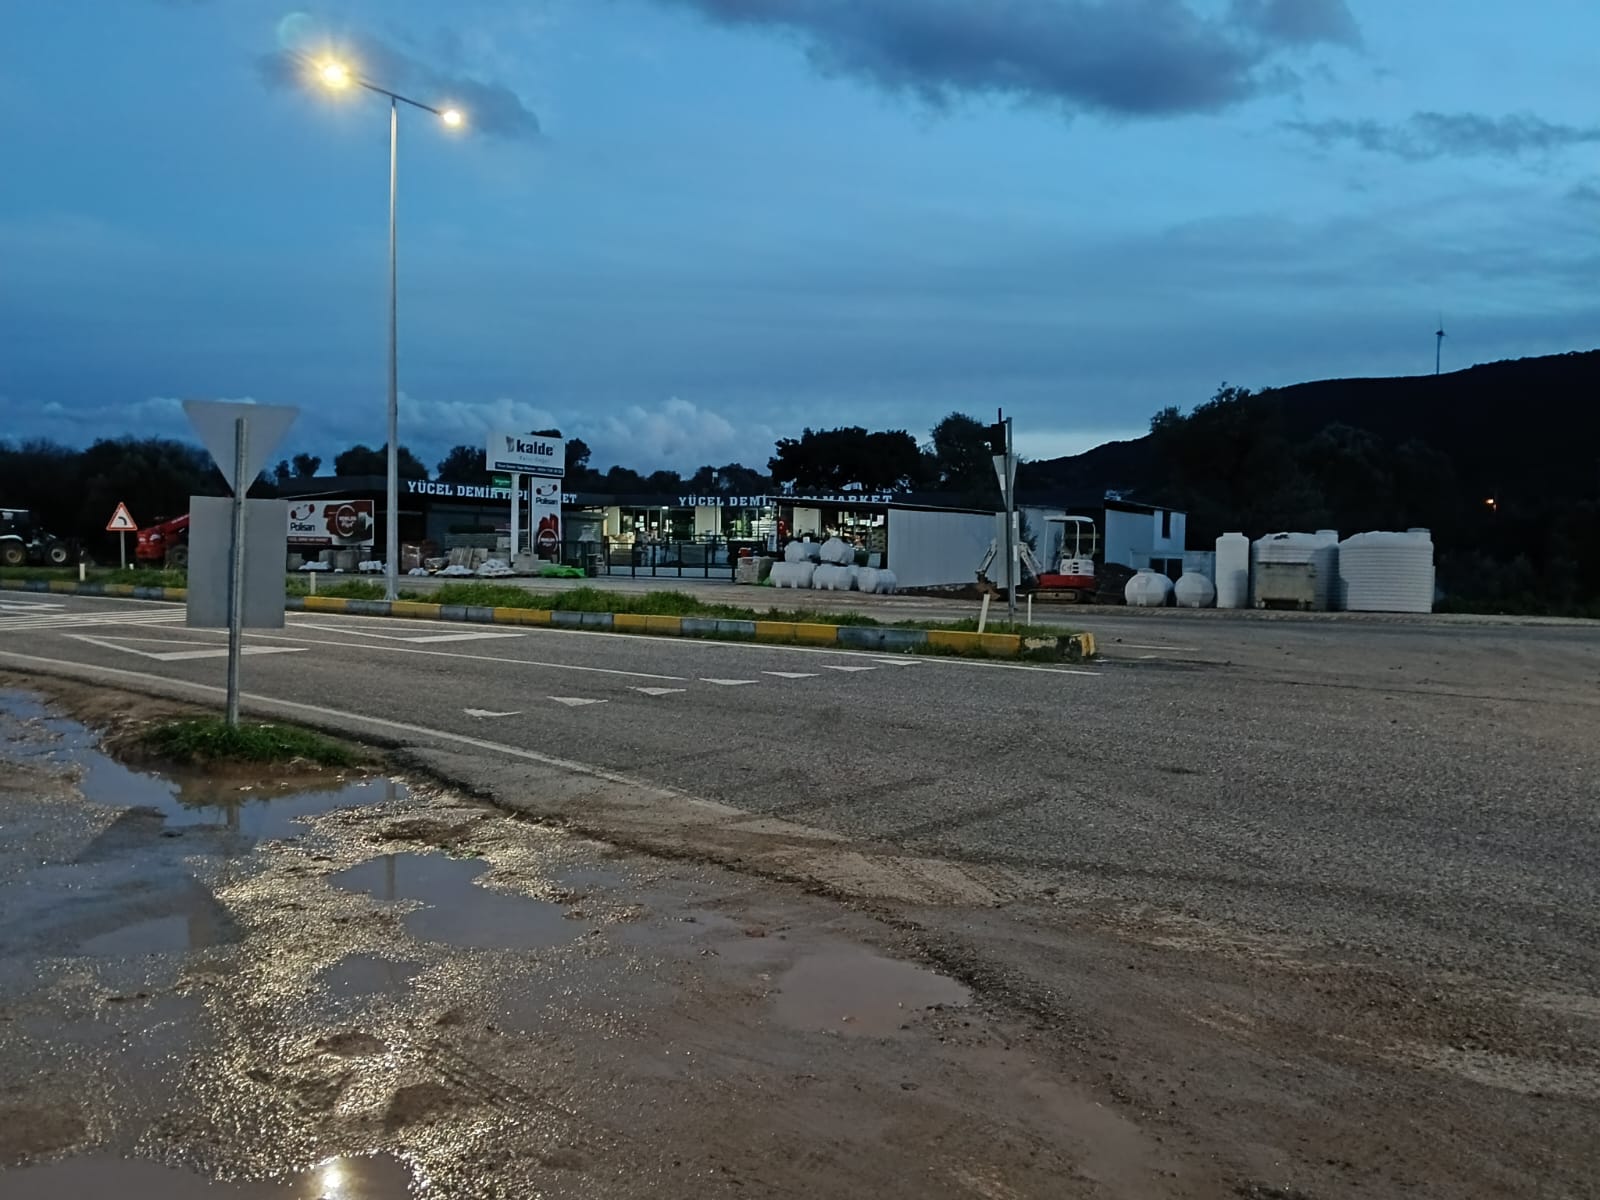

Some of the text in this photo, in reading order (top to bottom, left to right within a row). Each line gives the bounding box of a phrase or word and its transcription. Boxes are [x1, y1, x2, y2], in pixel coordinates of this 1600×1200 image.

[516, 439, 554, 456] kalde
[407, 479, 453, 496] YÜCEL
[678, 494, 725, 507] YÜCEL
[290, 521, 316, 532] Polisan
